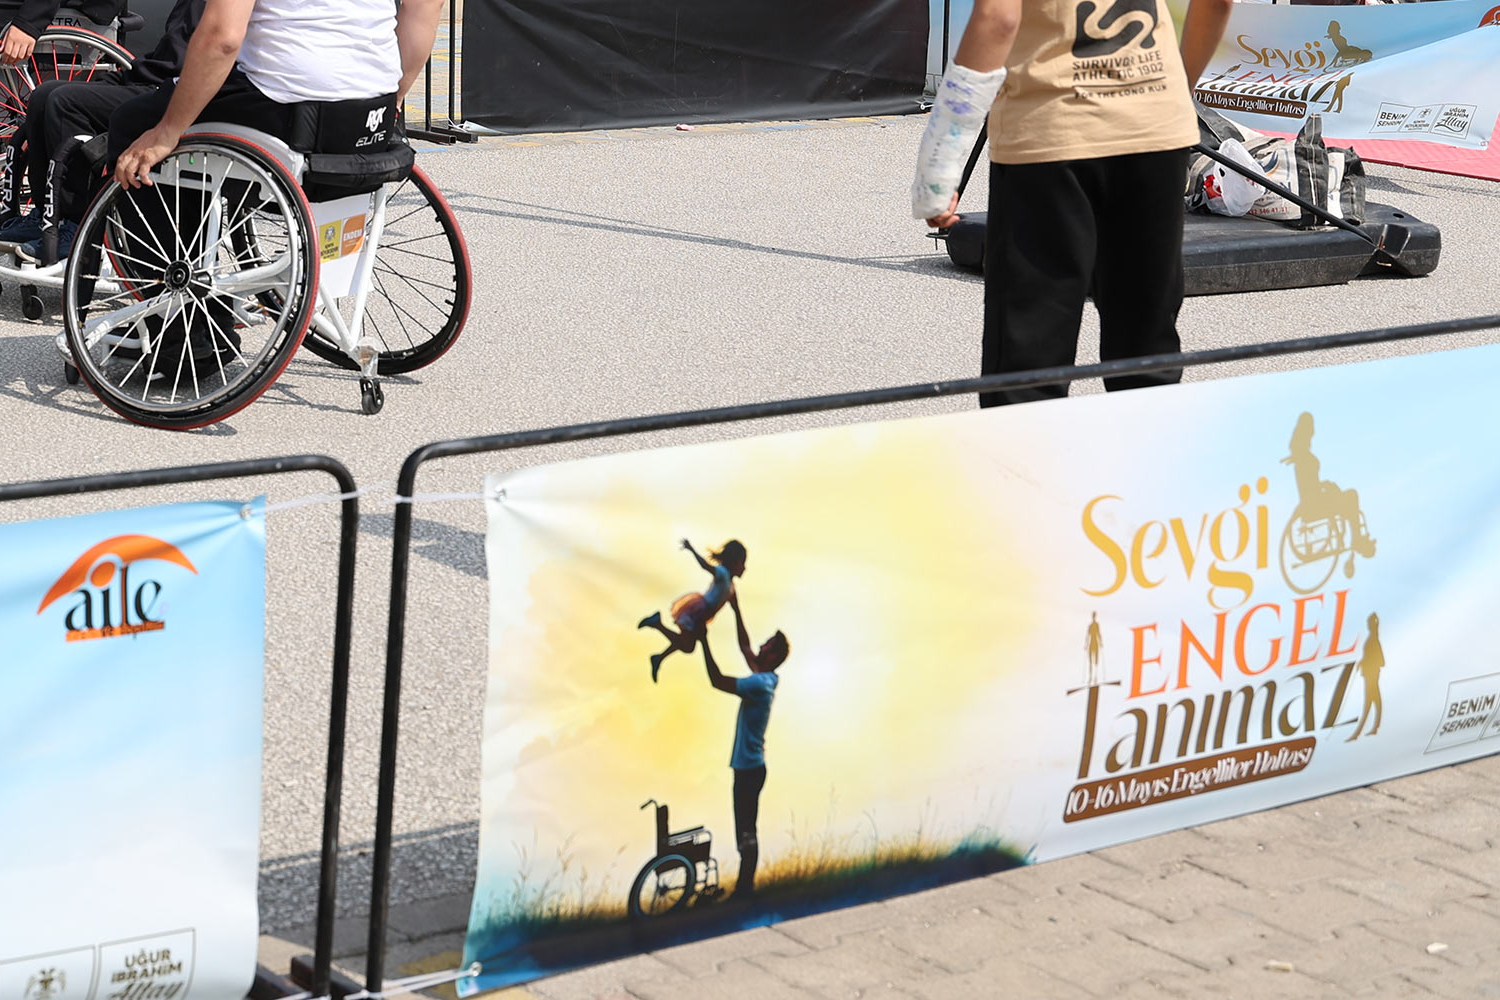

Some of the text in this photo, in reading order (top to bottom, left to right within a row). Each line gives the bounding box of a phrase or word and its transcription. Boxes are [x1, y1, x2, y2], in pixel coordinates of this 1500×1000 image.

[1137, 62, 1164, 77] 1902
[1138, 51, 1162, 64] LIFE
[1236, 34, 1326, 74] Sevgi
[1118, 86, 1145, 98] LONG
[355, 130, 387, 147] ELITE
[0, 144, 15, 215] EXTRA
[1079, 475, 1269, 611] Sevgi
[1126, 588, 1360, 700] ENGEL
[1067, 661, 1360, 780] Tanımaz
[1446, 693, 1496, 719] BENİM
[1066, 746, 1314, 816] 10-16 Mayıs Engelliler Haftası
[124, 948, 172, 969] UĞUR
